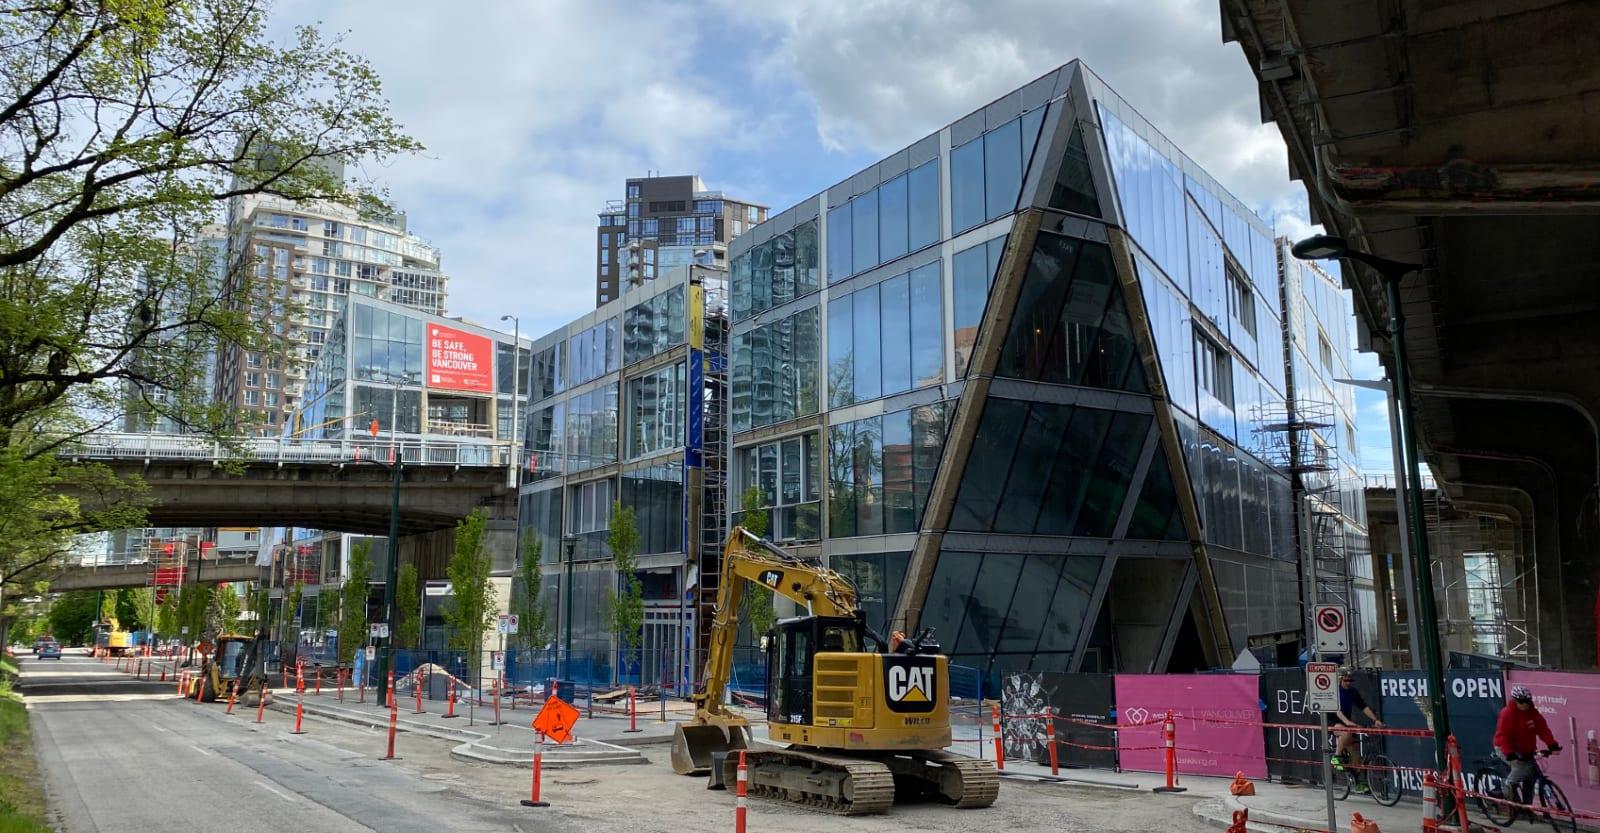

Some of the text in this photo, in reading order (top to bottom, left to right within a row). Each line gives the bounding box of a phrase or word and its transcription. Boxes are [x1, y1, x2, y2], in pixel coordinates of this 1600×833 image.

[432, 339, 442, 348] BE
[432, 349, 474, 362] BE STRONG
[432, 358, 477, 371] VANCOUVER
[766, 571, 778, 587] CAT
[888, 665, 934, 702] CAT
[1452, 678, 1502, 698] OPEN
